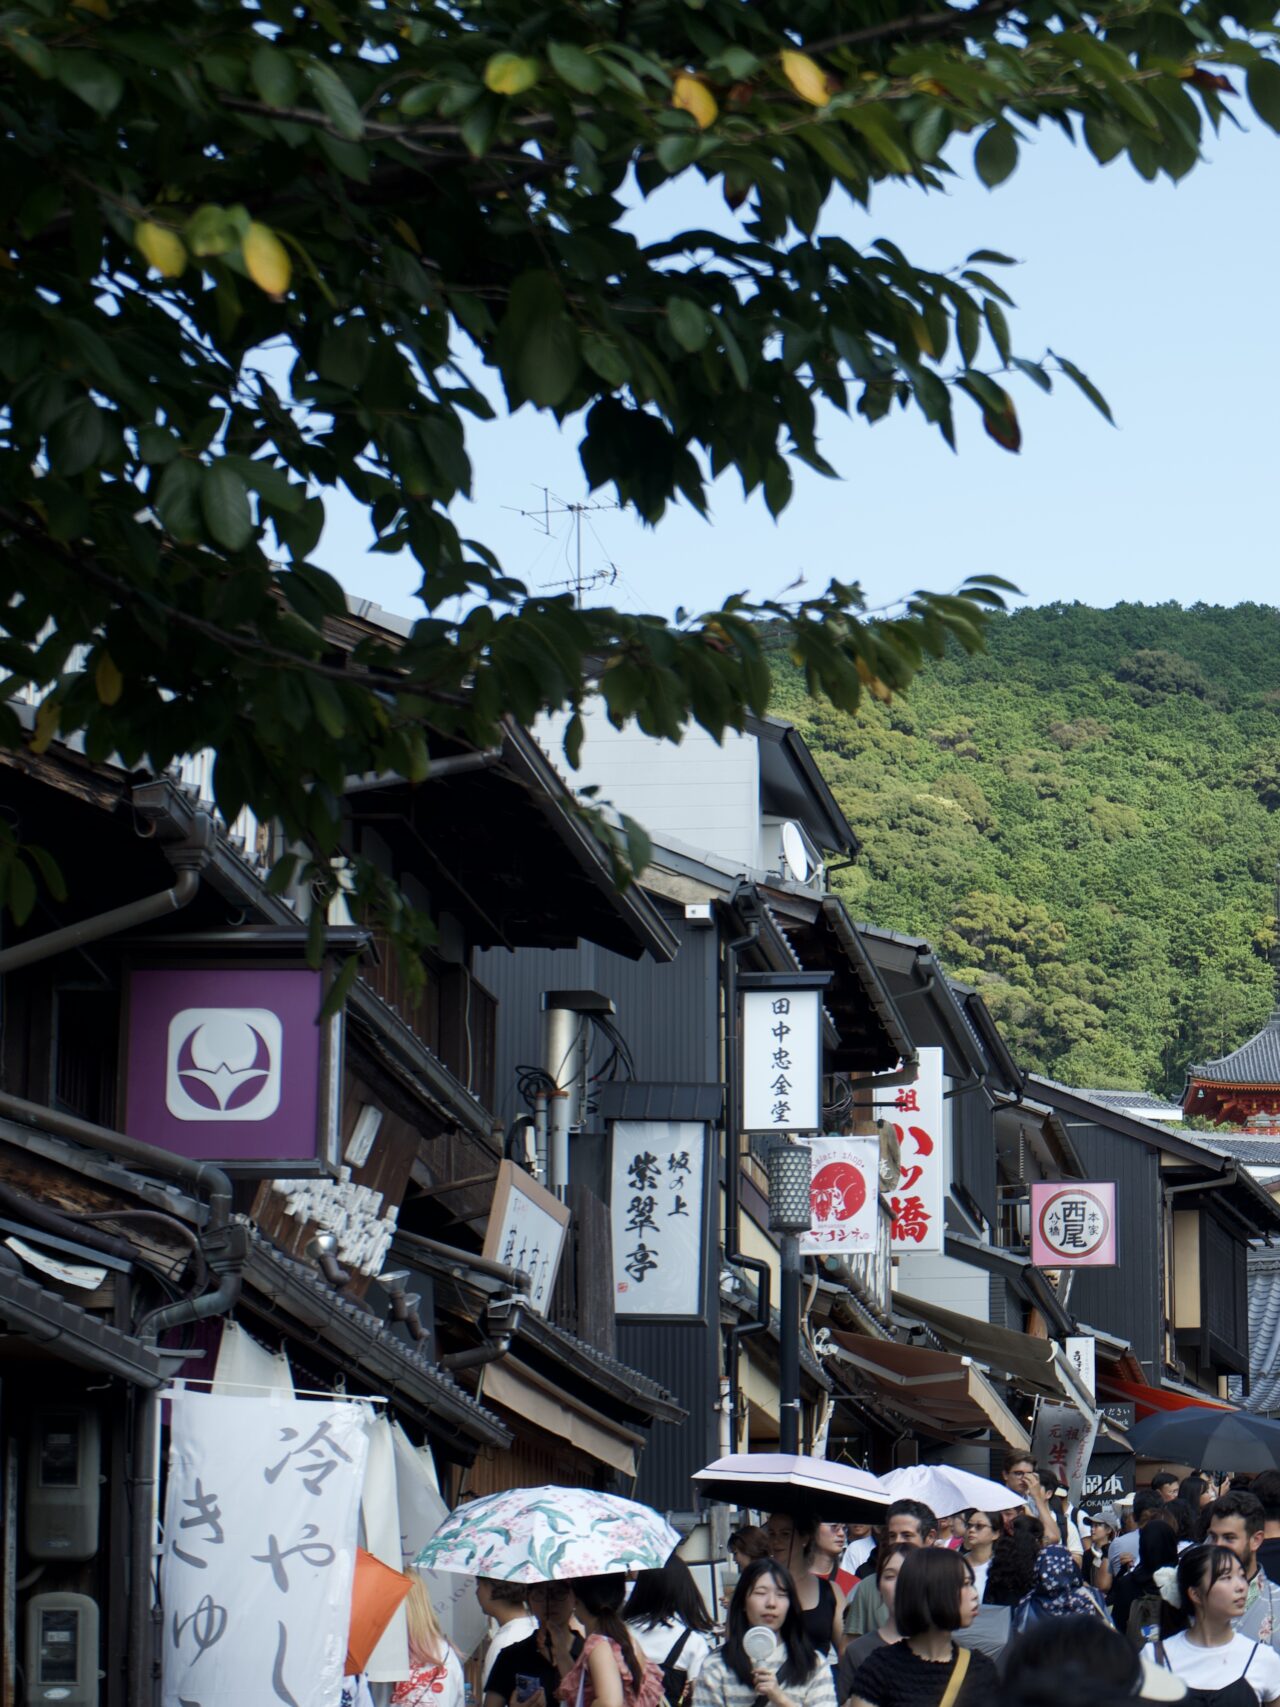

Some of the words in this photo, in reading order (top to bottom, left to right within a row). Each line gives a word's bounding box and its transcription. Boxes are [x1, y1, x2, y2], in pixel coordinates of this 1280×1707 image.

[770, 997, 792, 1123] 田中忠金堂
[667, 1151, 692, 1217] 坂の上
[625, 1151, 662, 1283] 紫翠亭
[1059, 1200, 1087, 1248] 西尾
[1088, 1210, 1100, 1236] 本家
[1081, 1474, 1124, 1496] 岡本
